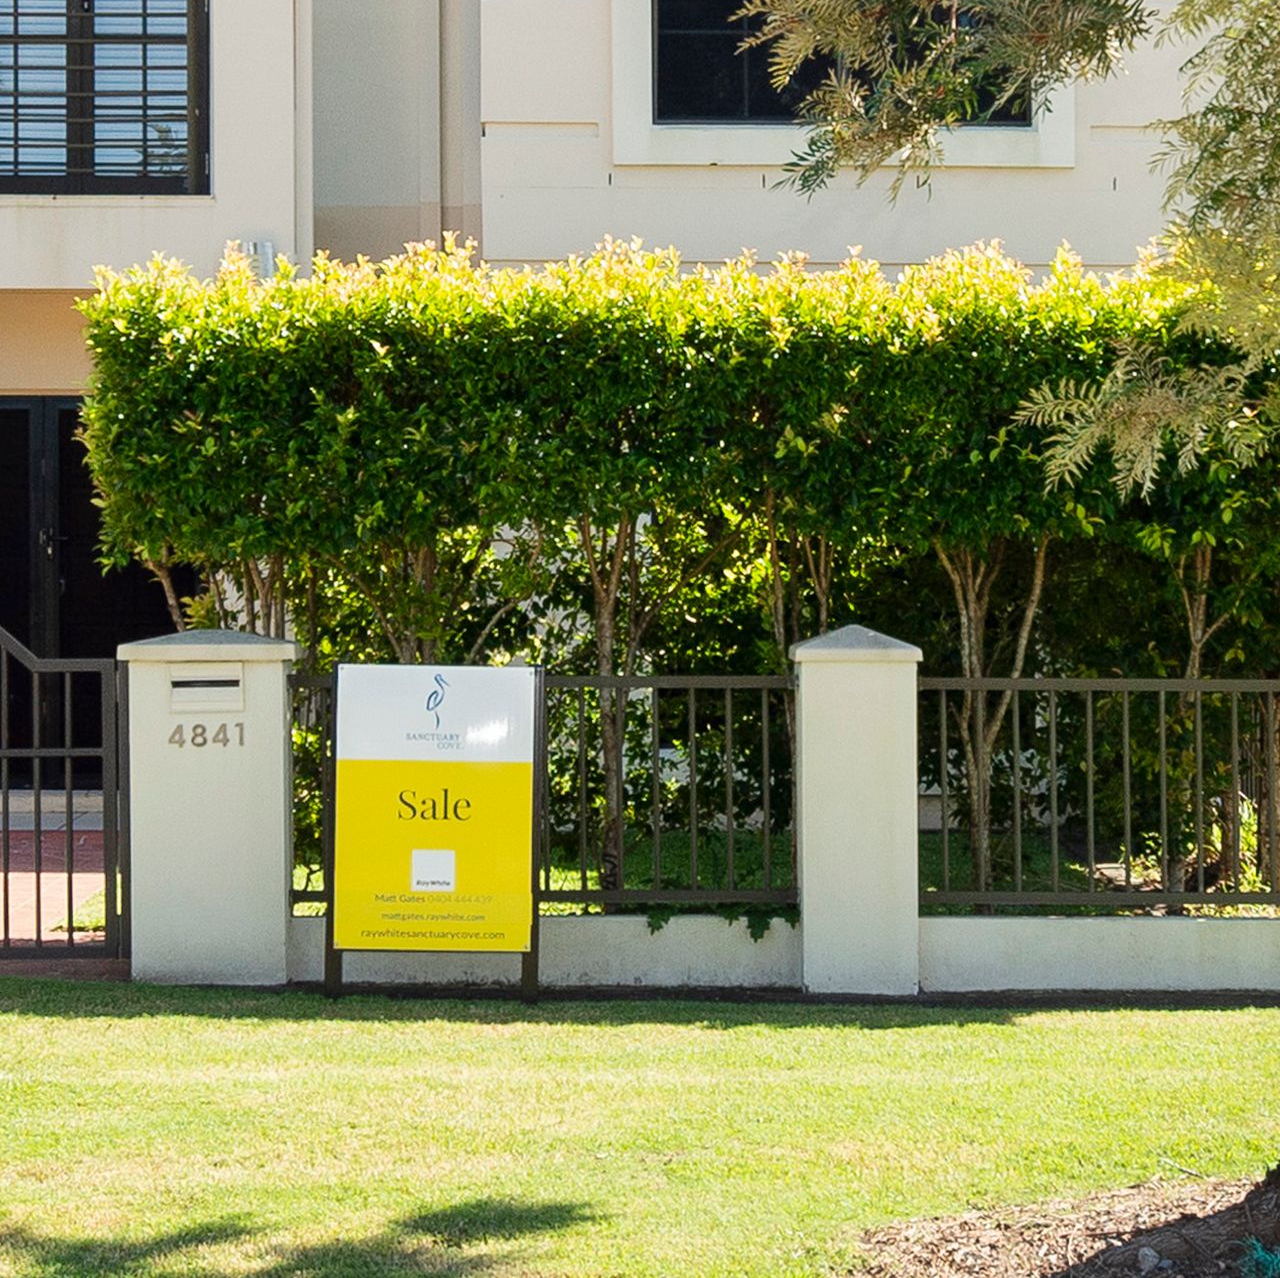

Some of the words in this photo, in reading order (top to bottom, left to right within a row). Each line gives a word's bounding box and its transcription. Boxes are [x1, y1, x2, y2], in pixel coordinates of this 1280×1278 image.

[168, 722, 245, 748] 4841
[405, 732, 460, 742] SANCTUARY
[397, 787, 472, 821] Sale
[375, 893, 397, 902] Matt
[361, 928, 505, 940] raywhitesanctuarycove.com
